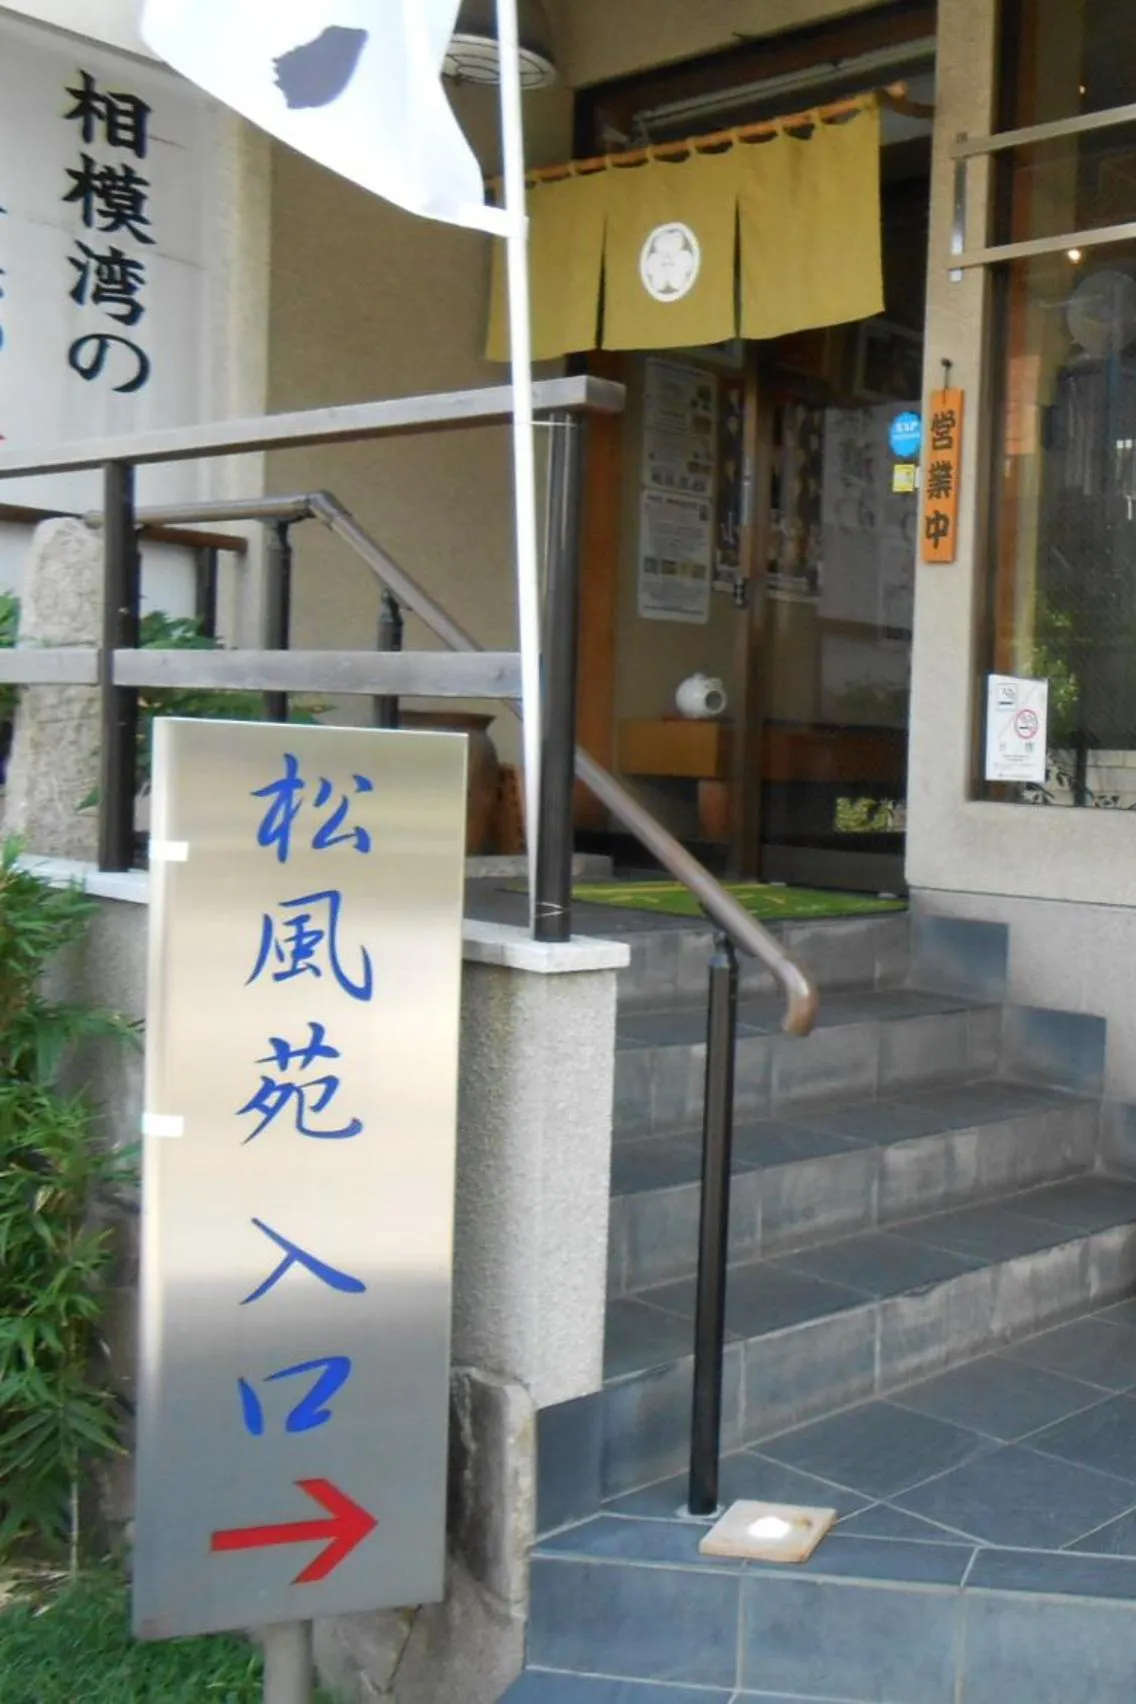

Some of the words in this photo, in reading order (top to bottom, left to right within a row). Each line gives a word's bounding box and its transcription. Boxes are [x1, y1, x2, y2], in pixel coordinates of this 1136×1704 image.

[62, 69, 157, 395] 相模湾の
[924, 409, 957, 550] 営業中
[234, 752, 376, 1437] 松風苑入口
